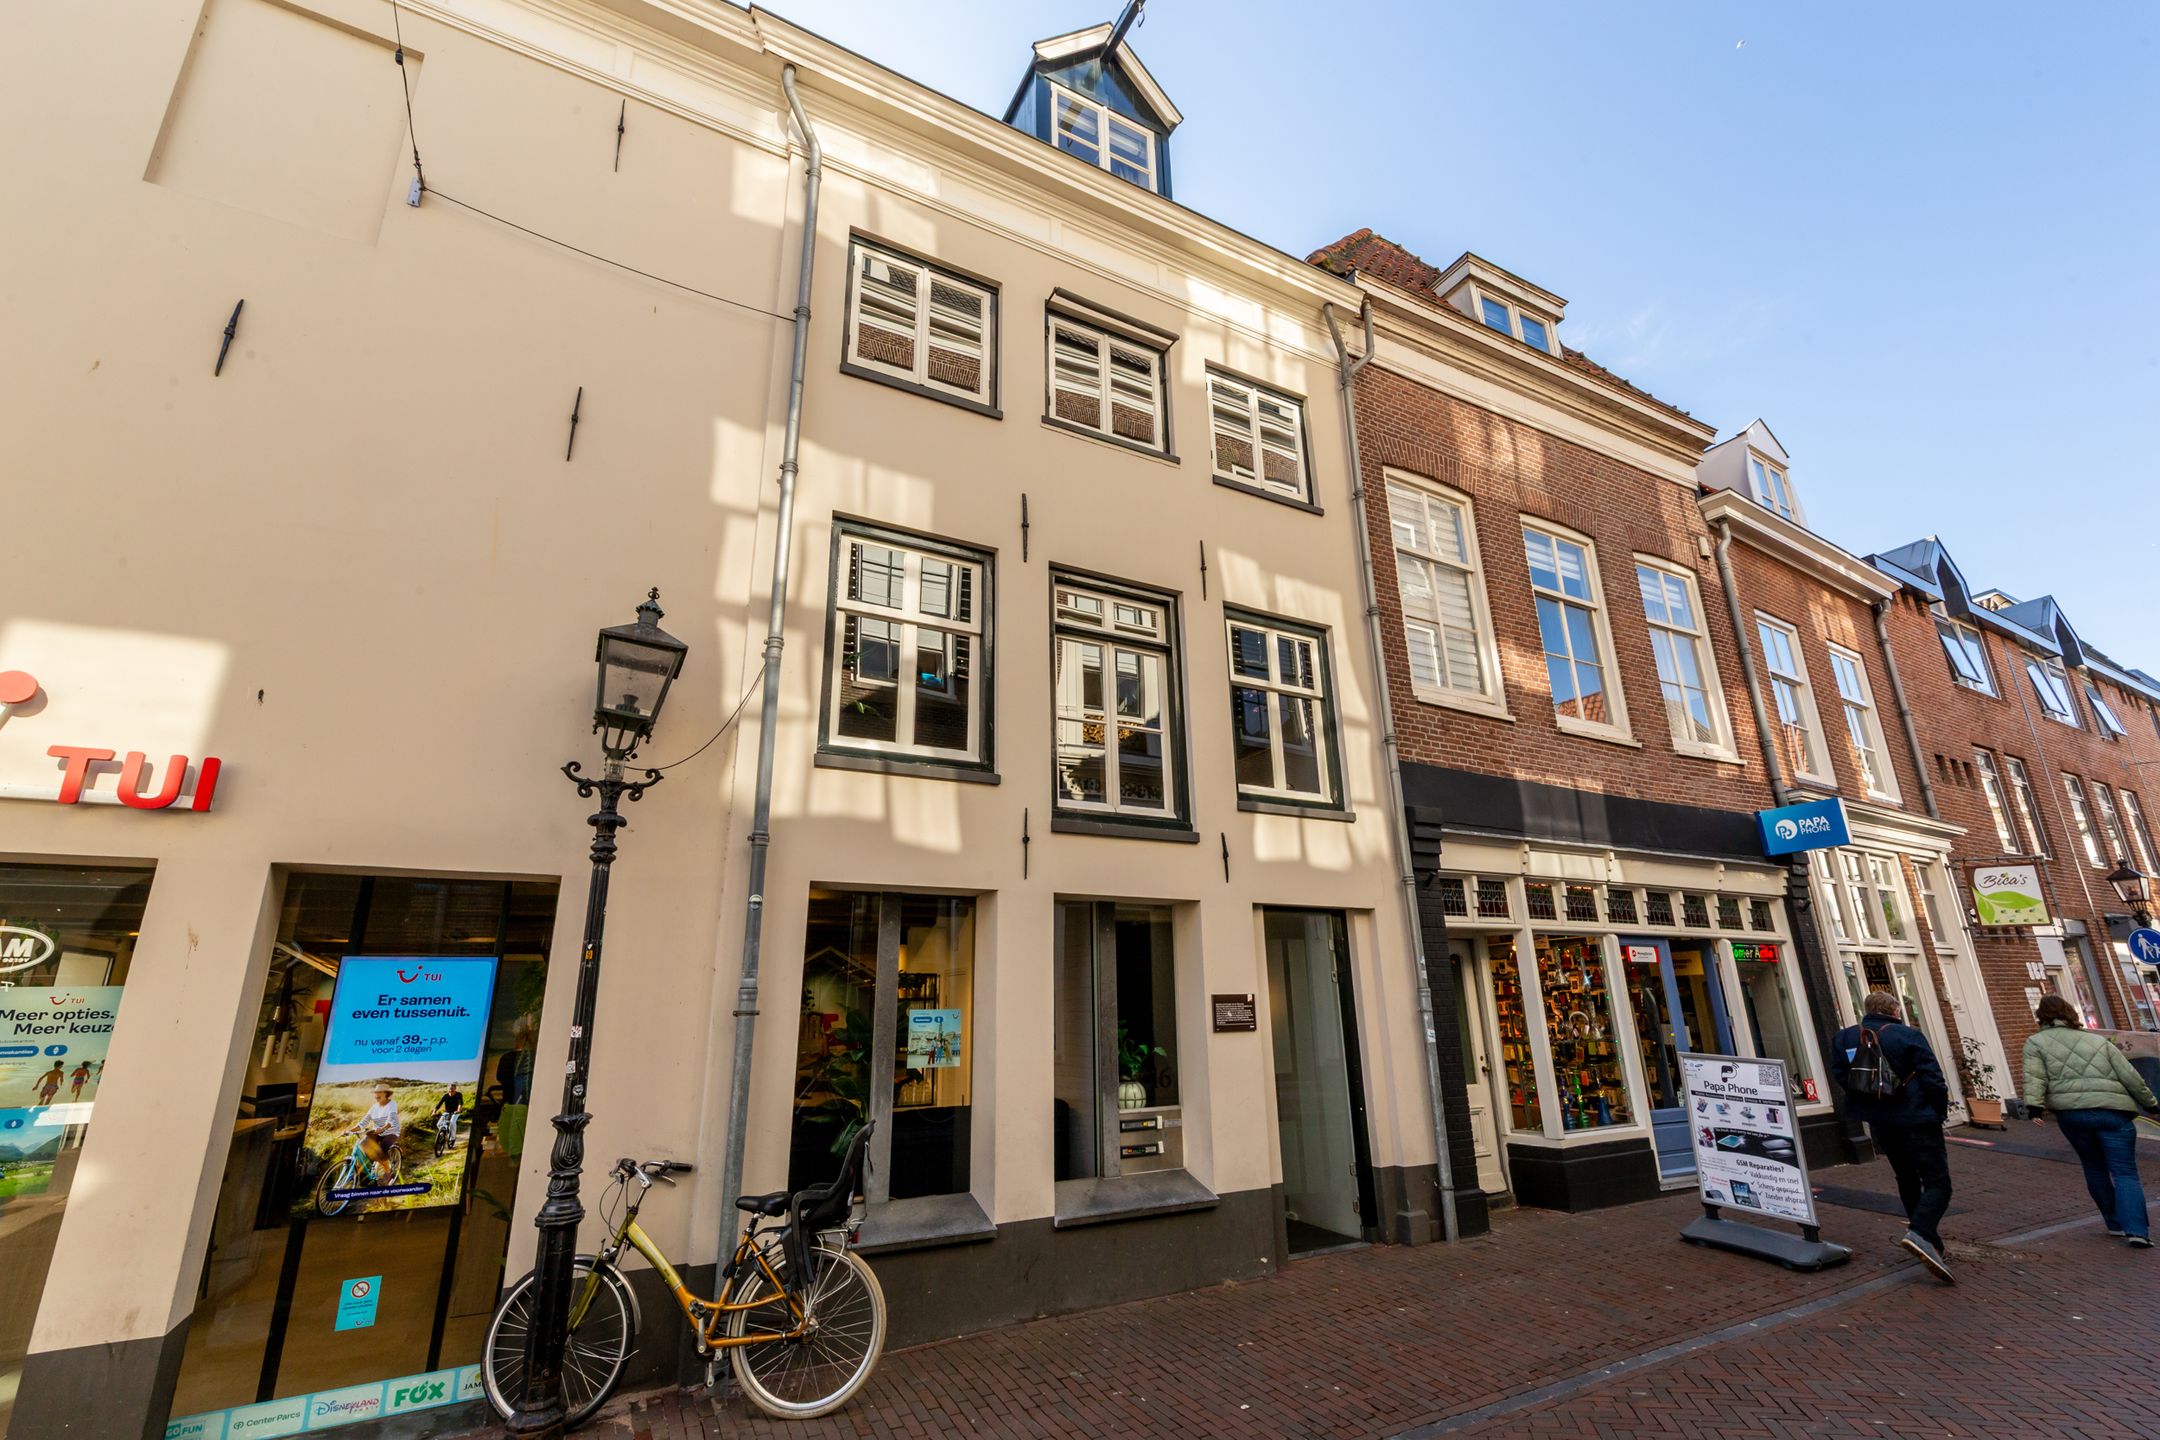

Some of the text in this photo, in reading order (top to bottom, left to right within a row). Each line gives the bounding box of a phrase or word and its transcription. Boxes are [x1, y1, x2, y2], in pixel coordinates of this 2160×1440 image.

[47, 745, 222, 812] TUI
[1798, 815, 1829, 828] PAPA
[1800, 825, 1831, 835] PHONE
[1979, 873, 2028, 888] Bica's
[424, 973, 442, 981] TUI
[377, 994, 451, 1006] Er samen
[0, 1008, 115, 1022] Meer opties.
[352, 1006, 470, 1019] even tussenuit.
[13, 1022, 114, 1035] Meer keuz
[371, 1036, 400, 1046] vanaf
[401, 1034, 428, 1045] 39,-
[430, 1037, 448, 1045] p.p.
[403, 1046, 432, 1055] dagen
[1703, 1080, 1726, 1093] Papa
[1728, 1083, 1759, 1096] Phone
[1736, 1159, 1748, 1167] GSM
[1748, 1161, 1785, 1173] Reparaties?
[393, 1380, 446, 1407] FOX
[246, 1411, 301, 1427] Center Parcs
[181, 1424, 203, 1435] FUN
